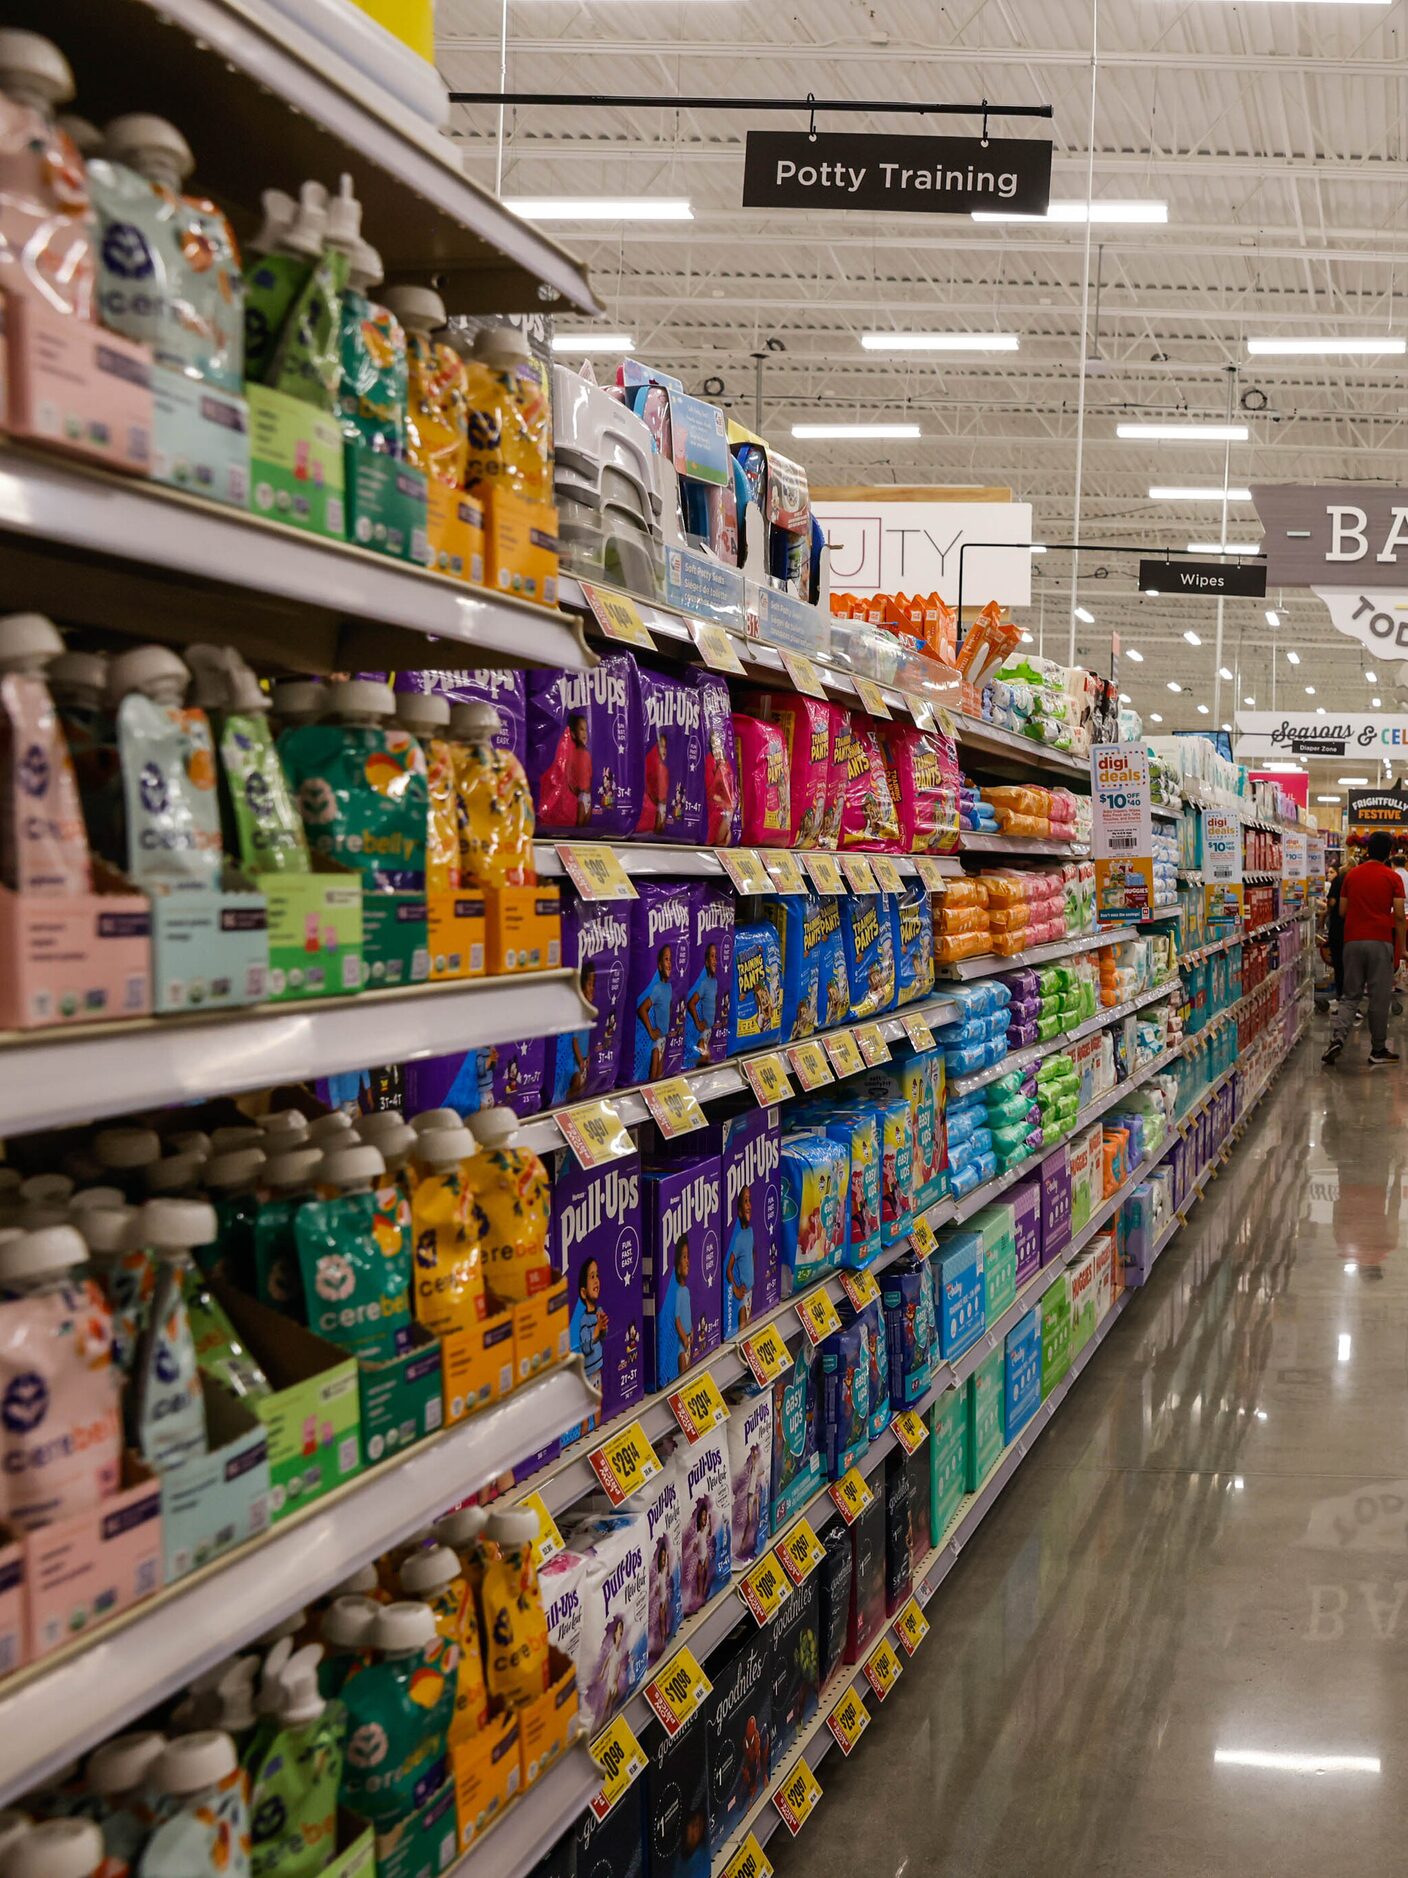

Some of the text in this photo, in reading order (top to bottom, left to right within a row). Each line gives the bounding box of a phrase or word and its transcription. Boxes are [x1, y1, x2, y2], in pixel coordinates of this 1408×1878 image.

[776, 160, 1020, 198] Potty Training
[1180, 572, 1226, 589] Wipes
[1271, 720, 1355, 747] Seasons
[1358, 725, 1378, 747] &
[1300, 744, 1320, 753] Diaper
[1098, 755, 1129, 771] digi
[1099, 769, 1141, 783] deals
[1099, 793, 1127, 809] $10
[1207, 818, 1227, 829] digi
[1358, 810, 1401, 821] FESTIVE
[1208, 826, 1236, 836] deals
[1208, 841, 1226, 852] $10
[854, 922, 880, 954] PANTS
[737, 953, 763, 974] TRAINING
[738, 968, 766, 994] PANTS
[785, 1391, 802, 1416] easy
[789, 1408, 803, 1433] ups
[611, 1441, 640, 1478] $2914
[664, 1668, 692, 1704] $1098
